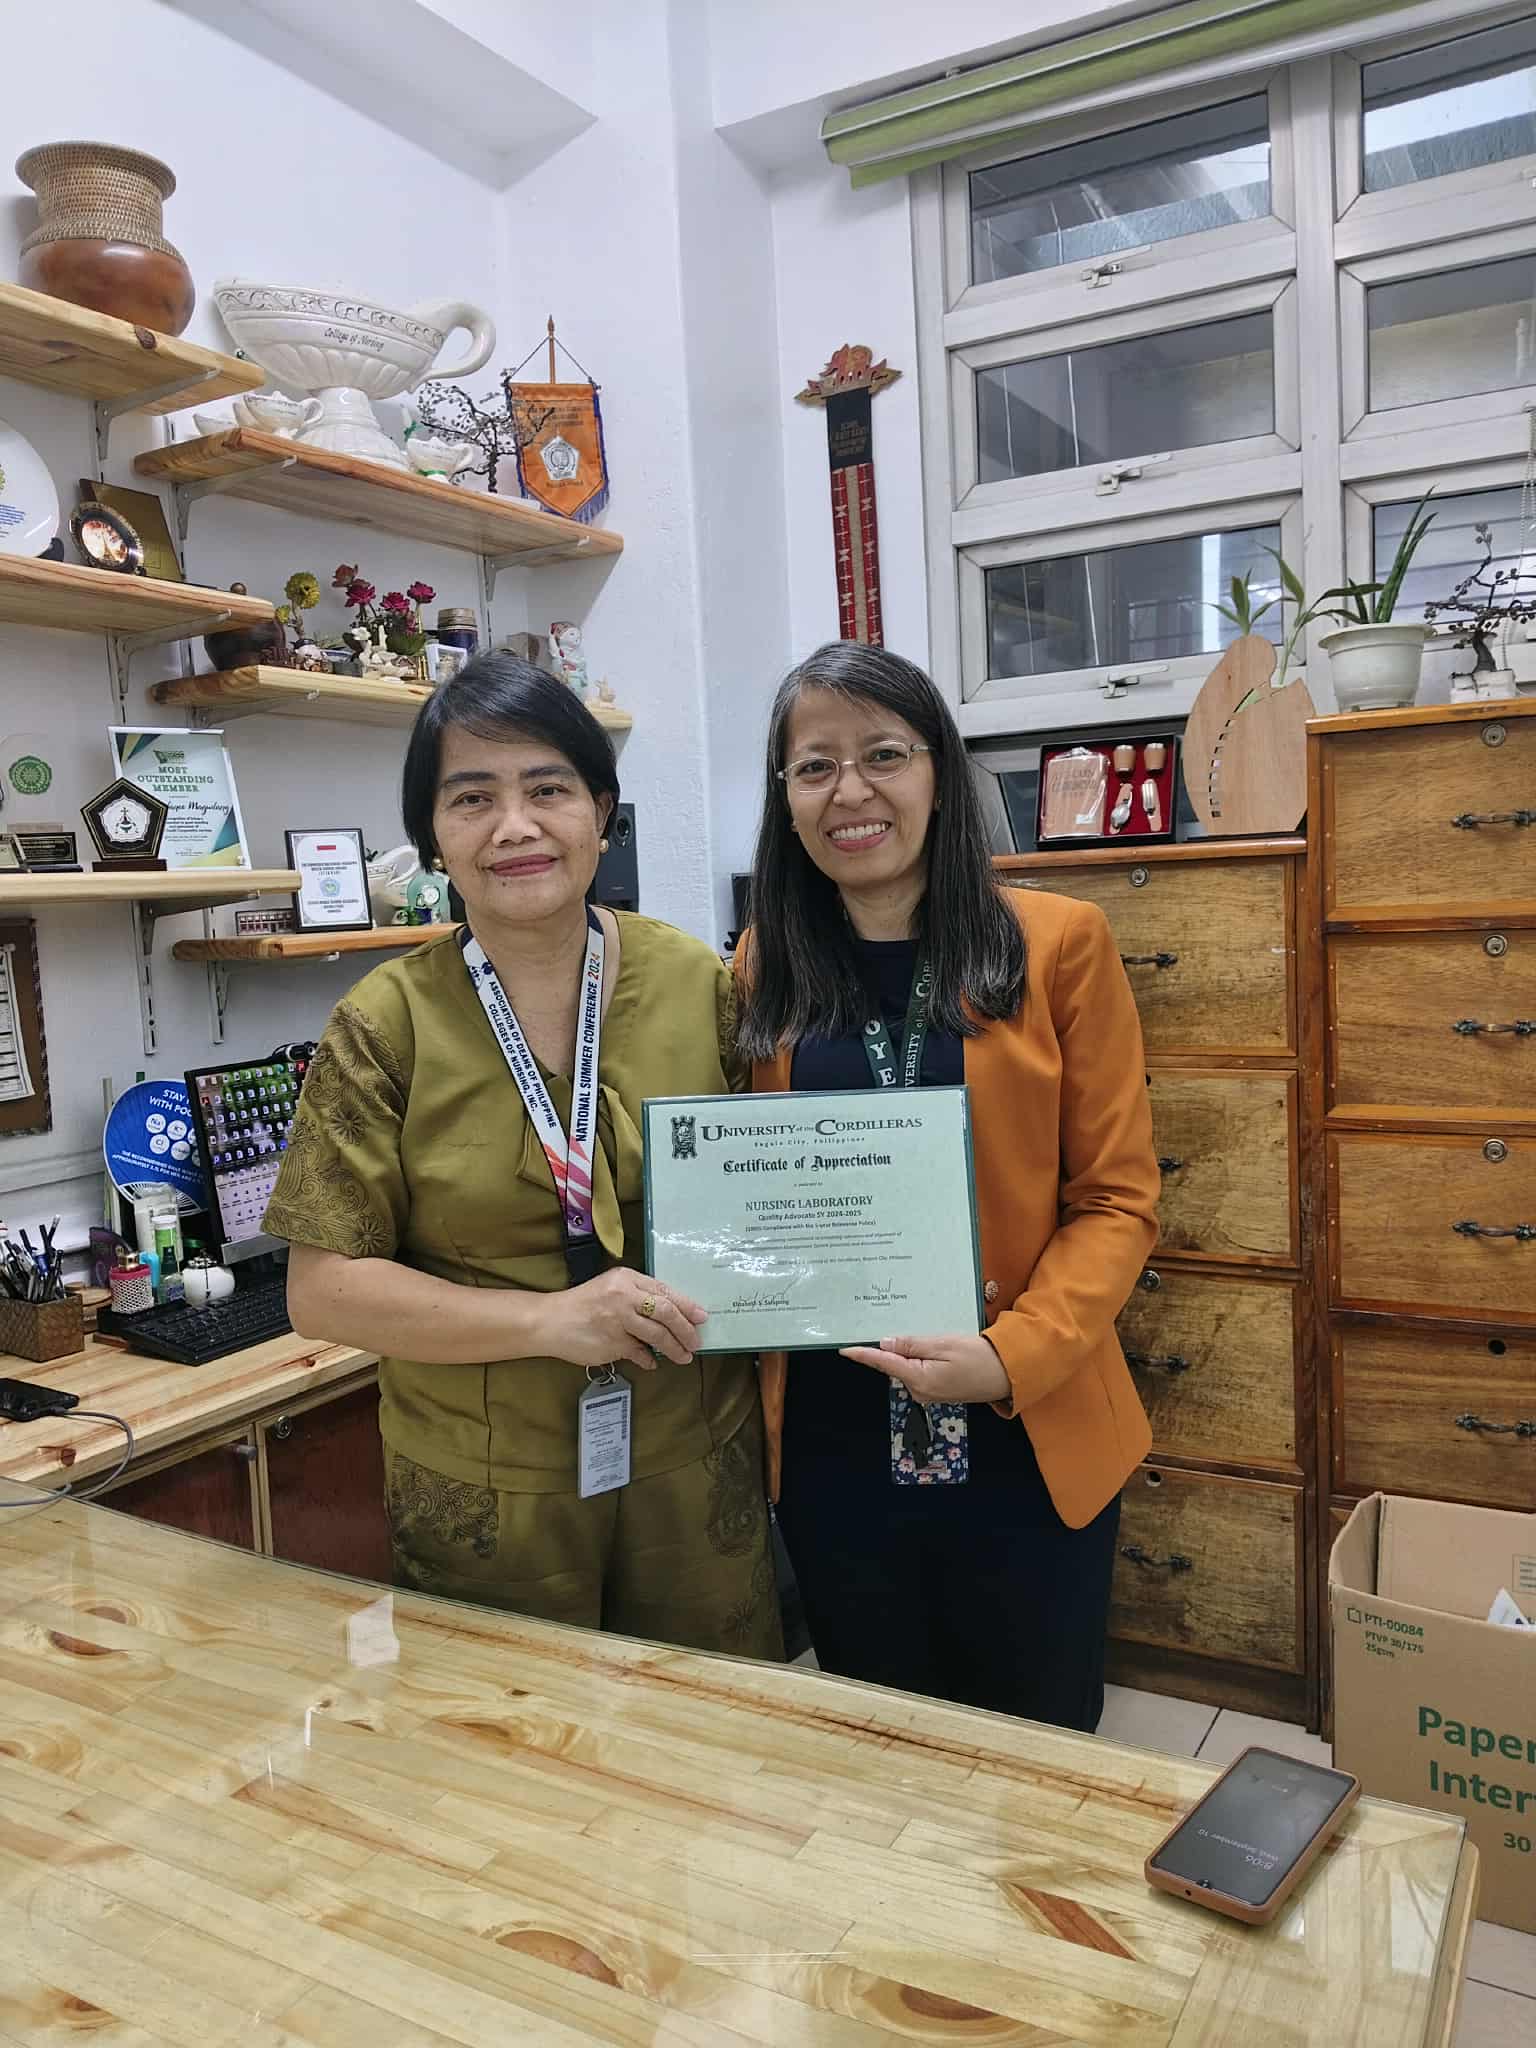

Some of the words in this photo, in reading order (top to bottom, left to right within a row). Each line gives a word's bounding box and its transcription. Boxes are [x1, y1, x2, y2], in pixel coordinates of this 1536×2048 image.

[324, 327, 349, 343] College
[358, 335, 385, 352] Nursing
[137, 775, 215, 784] OUTSTANDING
[158, 766, 189, 774] MOST
[152, 784, 200, 793] MEMBER
[588, 952, 601, 980] 2024
[584, 981, 598, 1043] CONFERENCE
[488, 1003, 510, 1043] COLLEGES
[506, 1044, 515, 1055] OF
[489, 981, 515, 1031] ASSOCIATION
[512, 1032, 521, 1043] OF
[517, 1042, 533, 1070] DEANS
[528, 1071, 538, 1082] OF
[534, 1083, 557, 1129] PHILIPPINE
[580, 1045, 593, 1089] SUMMER
[149, 1096, 172, 1110] WITH
[163, 1089, 186, 1101] STAY
[576, 1091, 591, 1142] NATIONAL
[700, 1125, 796, 1142] UNIVERSITY
[815, 1118, 923, 1136] CORDILLERAS
[723, 1158, 788, 1175] Certificate
[794, 1155, 806, 1169] of
[811, 1153, 892, 1171] Appreciation
[745, 1200, 795, 1211] NURSING
[798, 1196, 873, 1209] LABORATORY
[758, 1213, 782, 1222] Quality
[784, 1212, 815, 1220] Advocate
[816, 1211, 825, 1219] SY
[826, 1210, 862, 1218] 2024-2025
[1364, 1613, 1424, 1637] PTI-00084
[1503, 1832, 1532, 1852] 30
